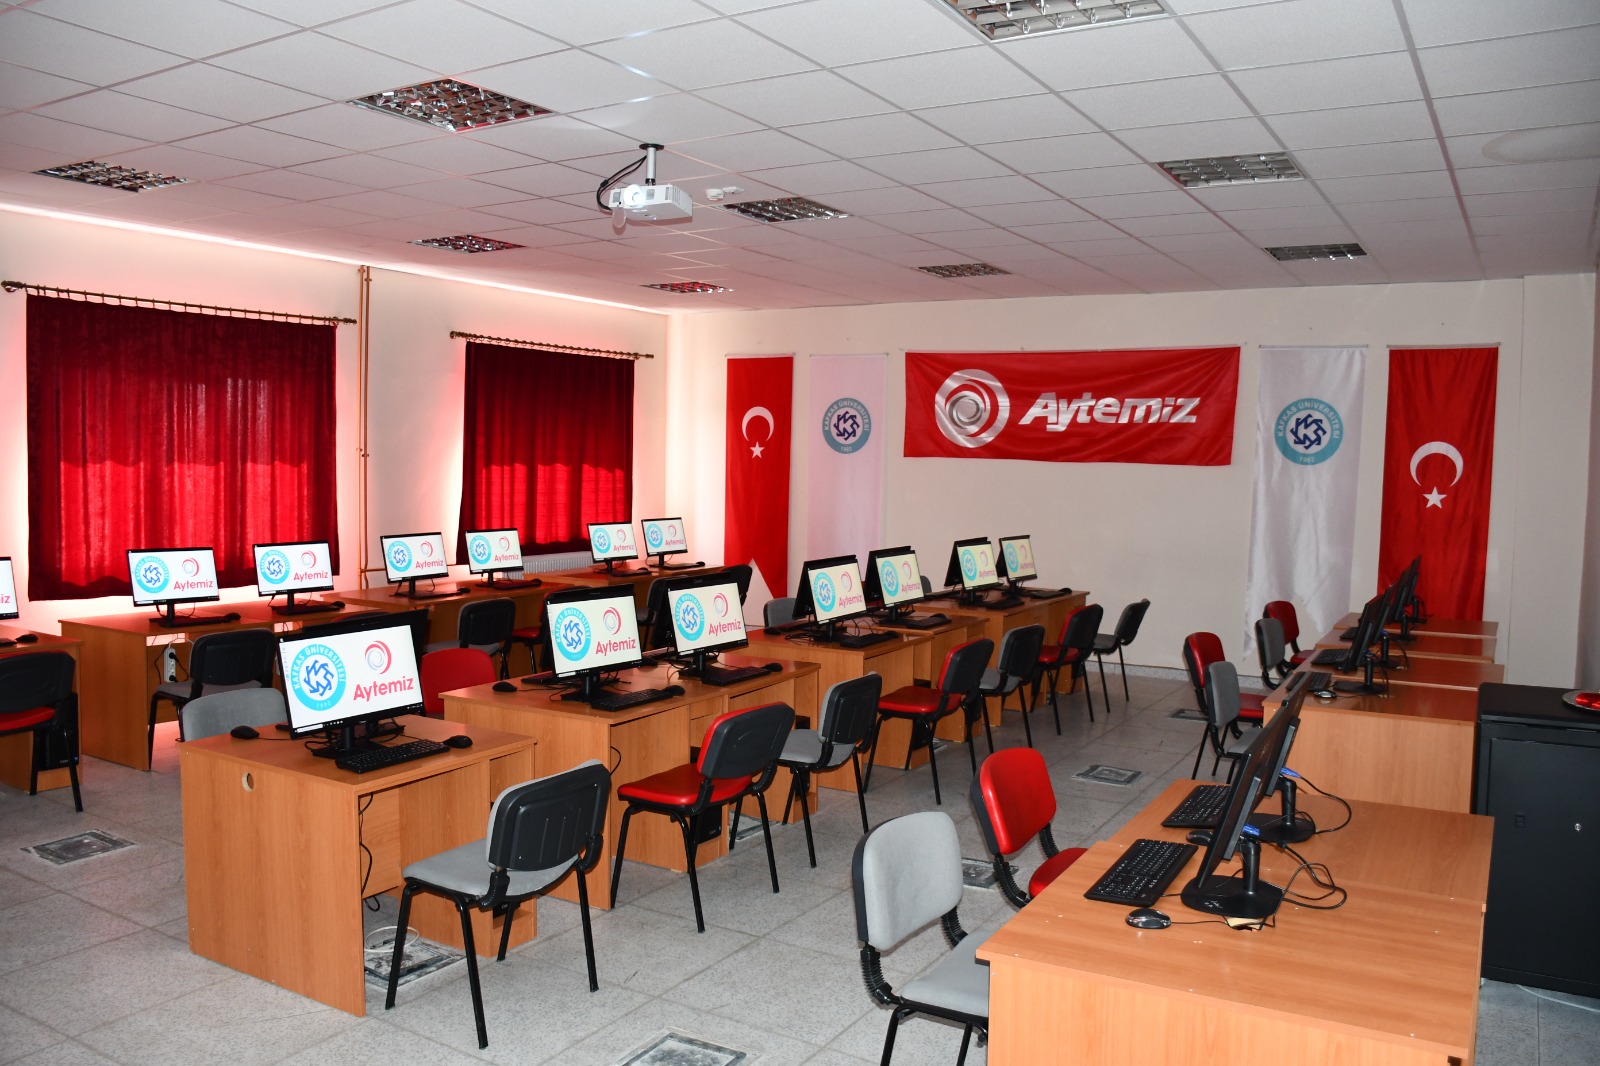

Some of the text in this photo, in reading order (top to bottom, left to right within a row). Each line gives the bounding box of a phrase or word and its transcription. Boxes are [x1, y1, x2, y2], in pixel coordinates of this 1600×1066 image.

[824, 404, 838, 431] KAFKAS
[1018, 391, 1201, 432] Aytemiz
[1277, 406, 1297, 437] KAFKAS
[415, 558, 444, 569] Aytemiz
[173, 579, 214, 591] Aytemiz
[293, 570, 329, 582] Aytemiz
[838, 594, 863, 609] Aytemiz
[708, 620, 742, 636] Aytemiz
[595, 637, 636, 656] Aytemiz
[290, 645, 346, 690] KAFKAS ÜNİVERSİTESİ
[353, 675, 414, 702] Aytemiz
